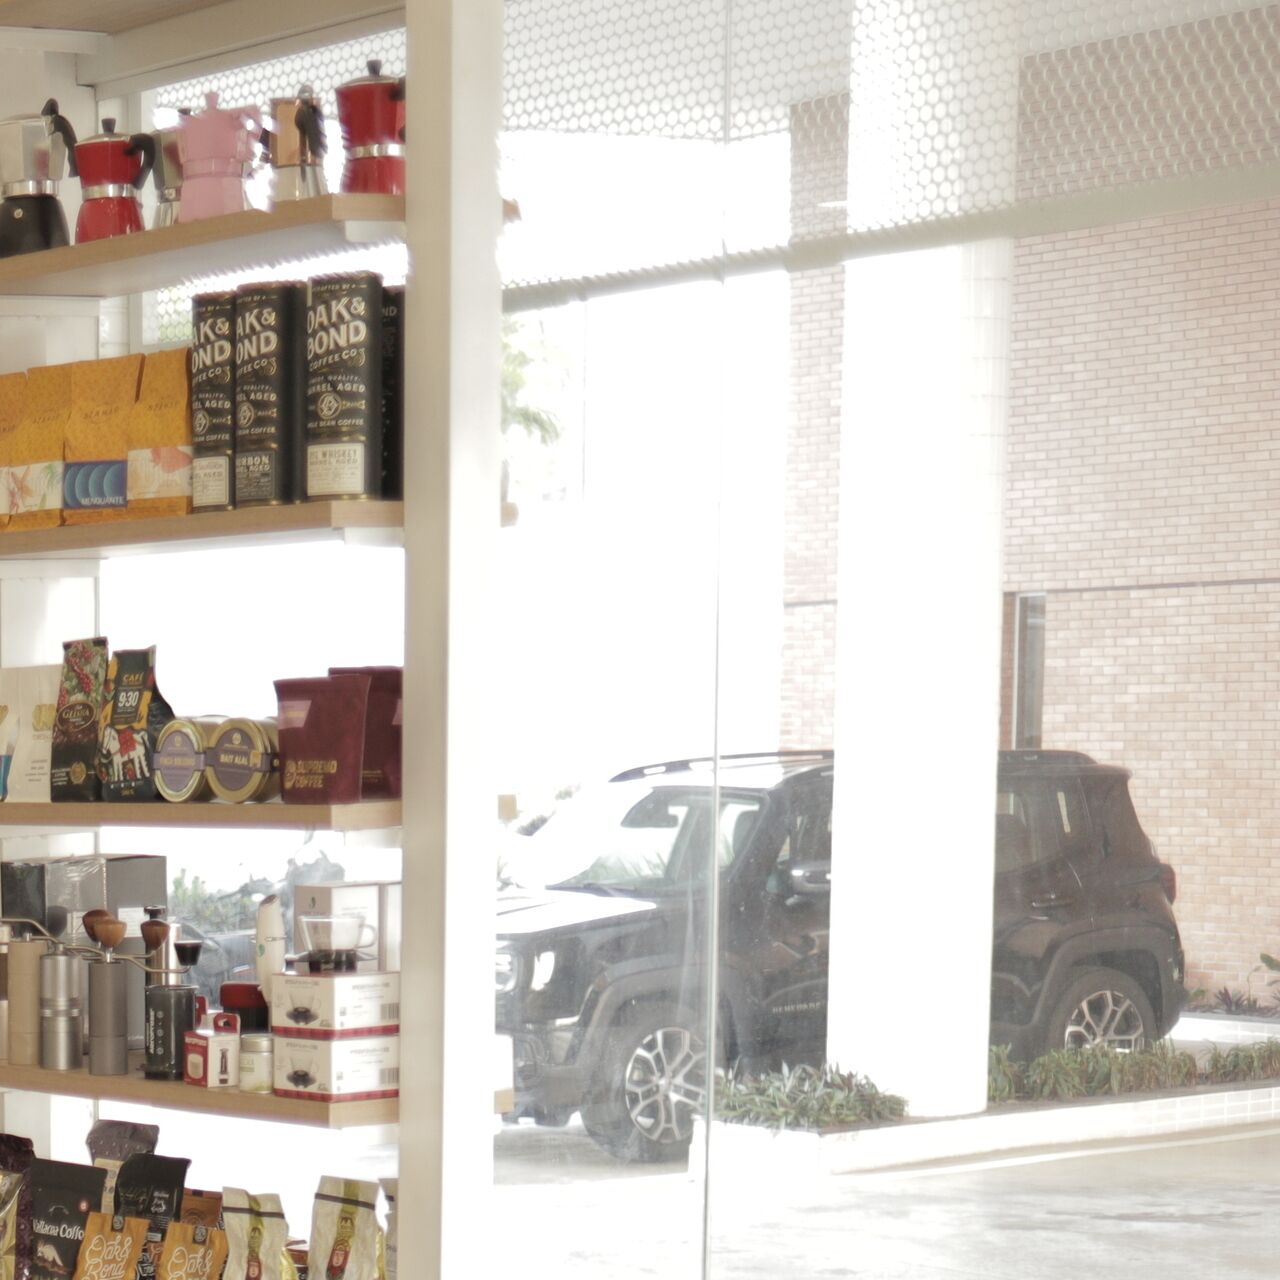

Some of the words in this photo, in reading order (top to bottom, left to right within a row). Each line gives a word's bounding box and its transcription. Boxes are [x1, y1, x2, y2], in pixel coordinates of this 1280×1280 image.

[192, 340, 231, 373] OND
[236, 331, 278, 364] OND
[307, 320, 366, 361] BOND
[337, 383, 366, 392] AGED
